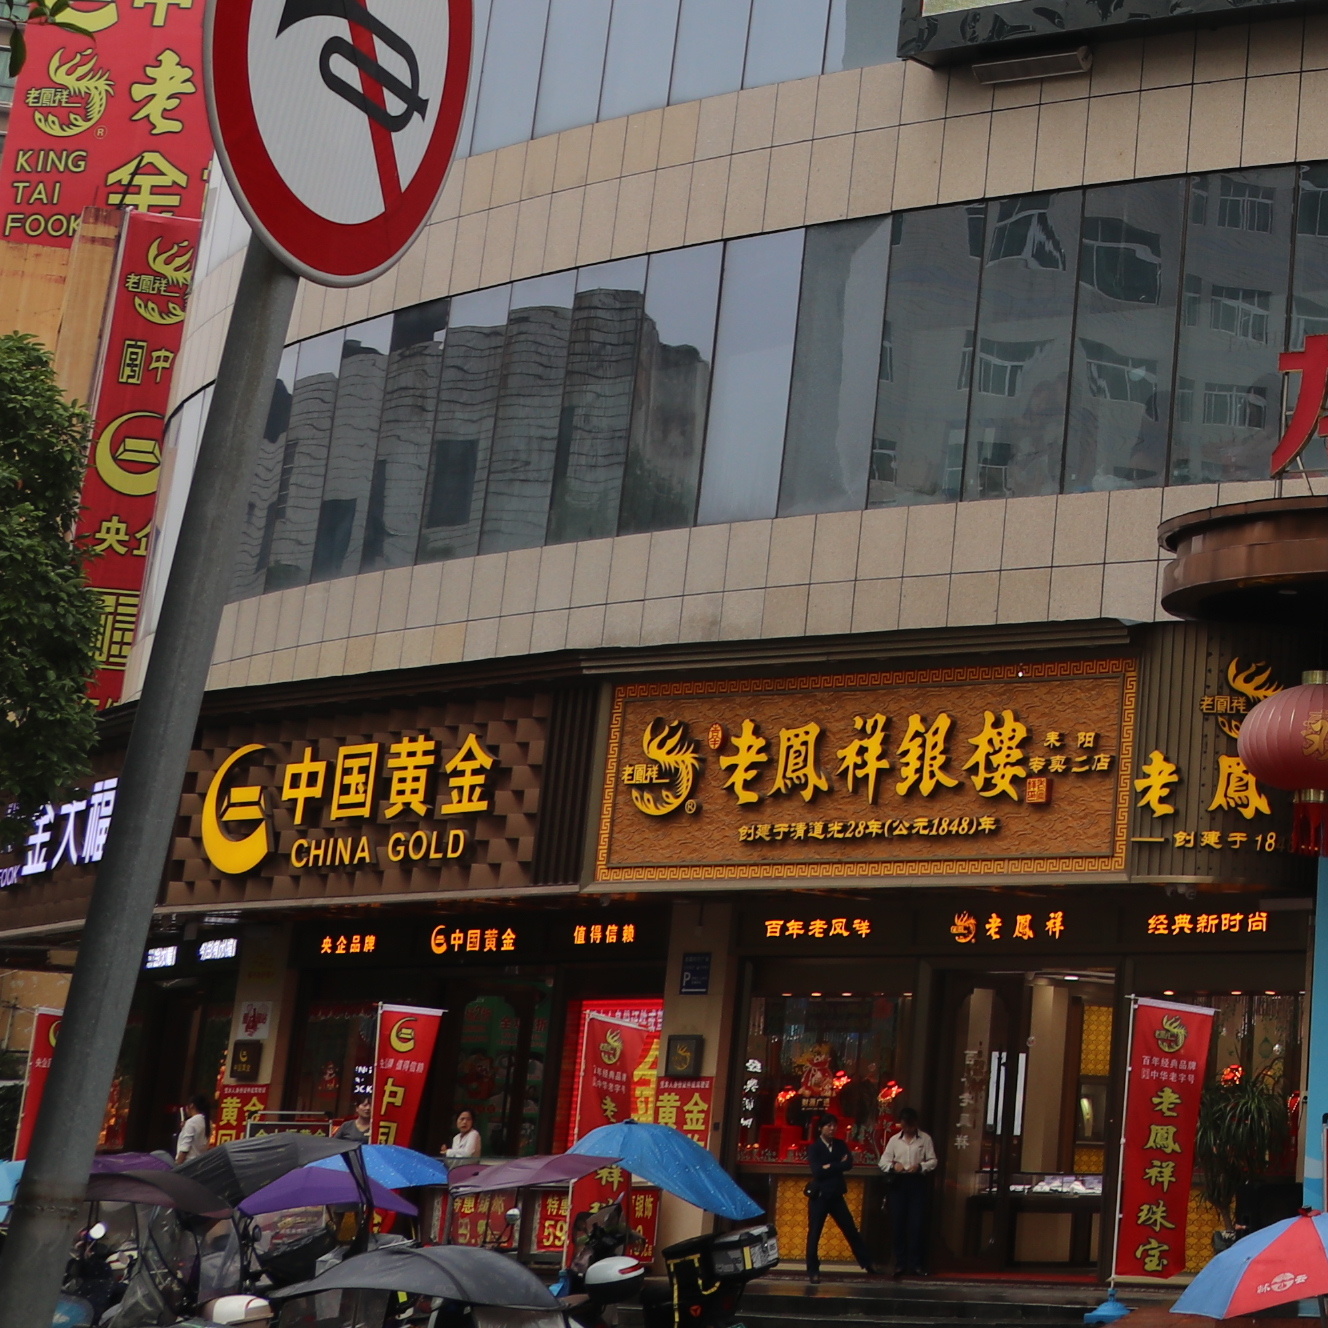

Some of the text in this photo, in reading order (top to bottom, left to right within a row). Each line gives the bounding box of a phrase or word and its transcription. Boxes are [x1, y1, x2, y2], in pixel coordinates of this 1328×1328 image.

[16, 150, 88, 173] KING
[13, 182, 61, 205] TAI
[4, 214, 82, 238] FOOK
[719, 709, 1030, 805] 老鳳祥銀樓
[281, 732, 494, 825] 中国黄金
[290, 829, 467, 869] CHINA GOLD
[573, 924, 636, 946] 值得信赖
[763, 918, 872, 939] 百年老凤祥
[985, 911, 1065, 941] 老鳳祥
[1146, 910, 1269, 937] 经典新时尚
[320, 934, 376, 955] 央企品牌
[449, 927, 517, 953] 中国黄金
[656, 1092, 709, 1131] 黄金
